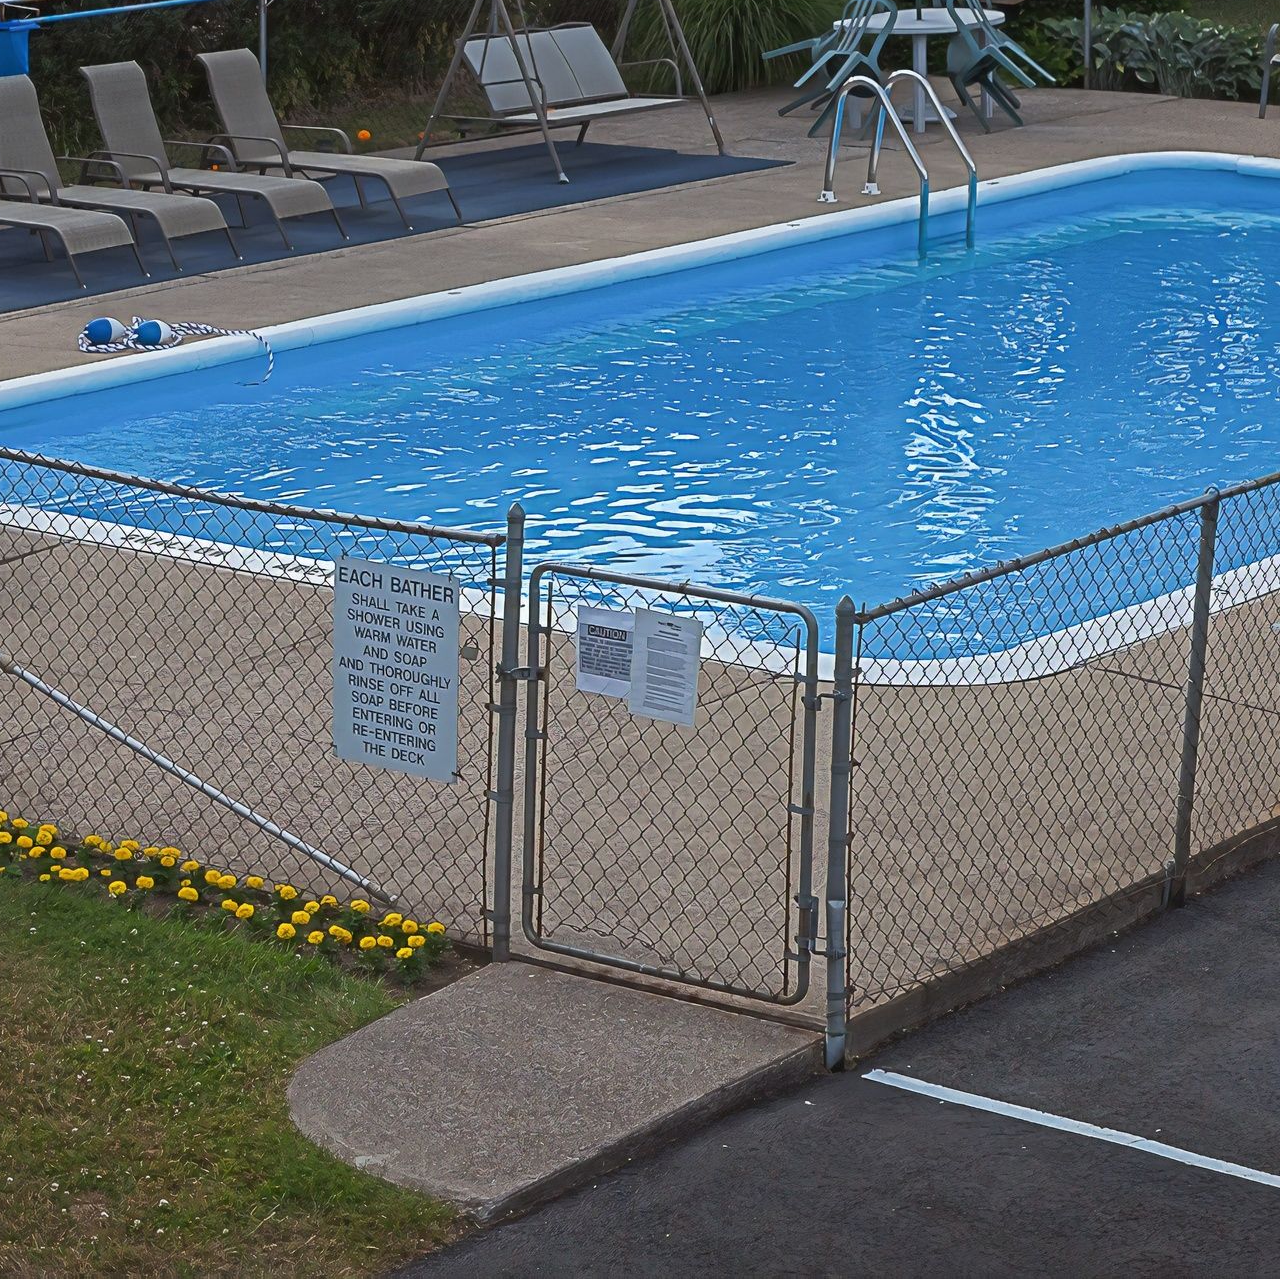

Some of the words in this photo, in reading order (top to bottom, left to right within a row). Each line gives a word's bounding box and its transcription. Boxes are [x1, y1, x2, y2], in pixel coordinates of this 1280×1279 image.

[339, 566, 383, 589] EACH
[391, 576, 454, 603] BATHER
[352, 592, 390, 611] SHALL
[395, 601, 426, 619] TAKE
[431, 609, 440, 621] A
[347, 608, 400, 629] SHOWER
[406, 620, 445, 638] USING
[587, 625, 626, 641] CAUTION
[354, 625, 391, 643] WARM
[396, 633, 437, 653] WATER
[363, 645, 388, 660] AND
[394, 650, 428, 668] SOAP
[339, 656, 364, 671] AND
[369, 662, 451, 690] THOROUGHLY
[348, 673, 385, 692] RINSE
[390, 682, 414, 697] OFF
[419, 689, 441, 705] ALL
[351, 690, 384, 707] SOAP
[389, 698, 438, 720] BEFORE
[352, 707, 413, 731] ENTERING
[418, 721, 436, 735] OR
[352, 723, 436, 752] RE-ENTERING
[362, 741, 386, 757] THE
[391, 747, 425, 766] DECK
